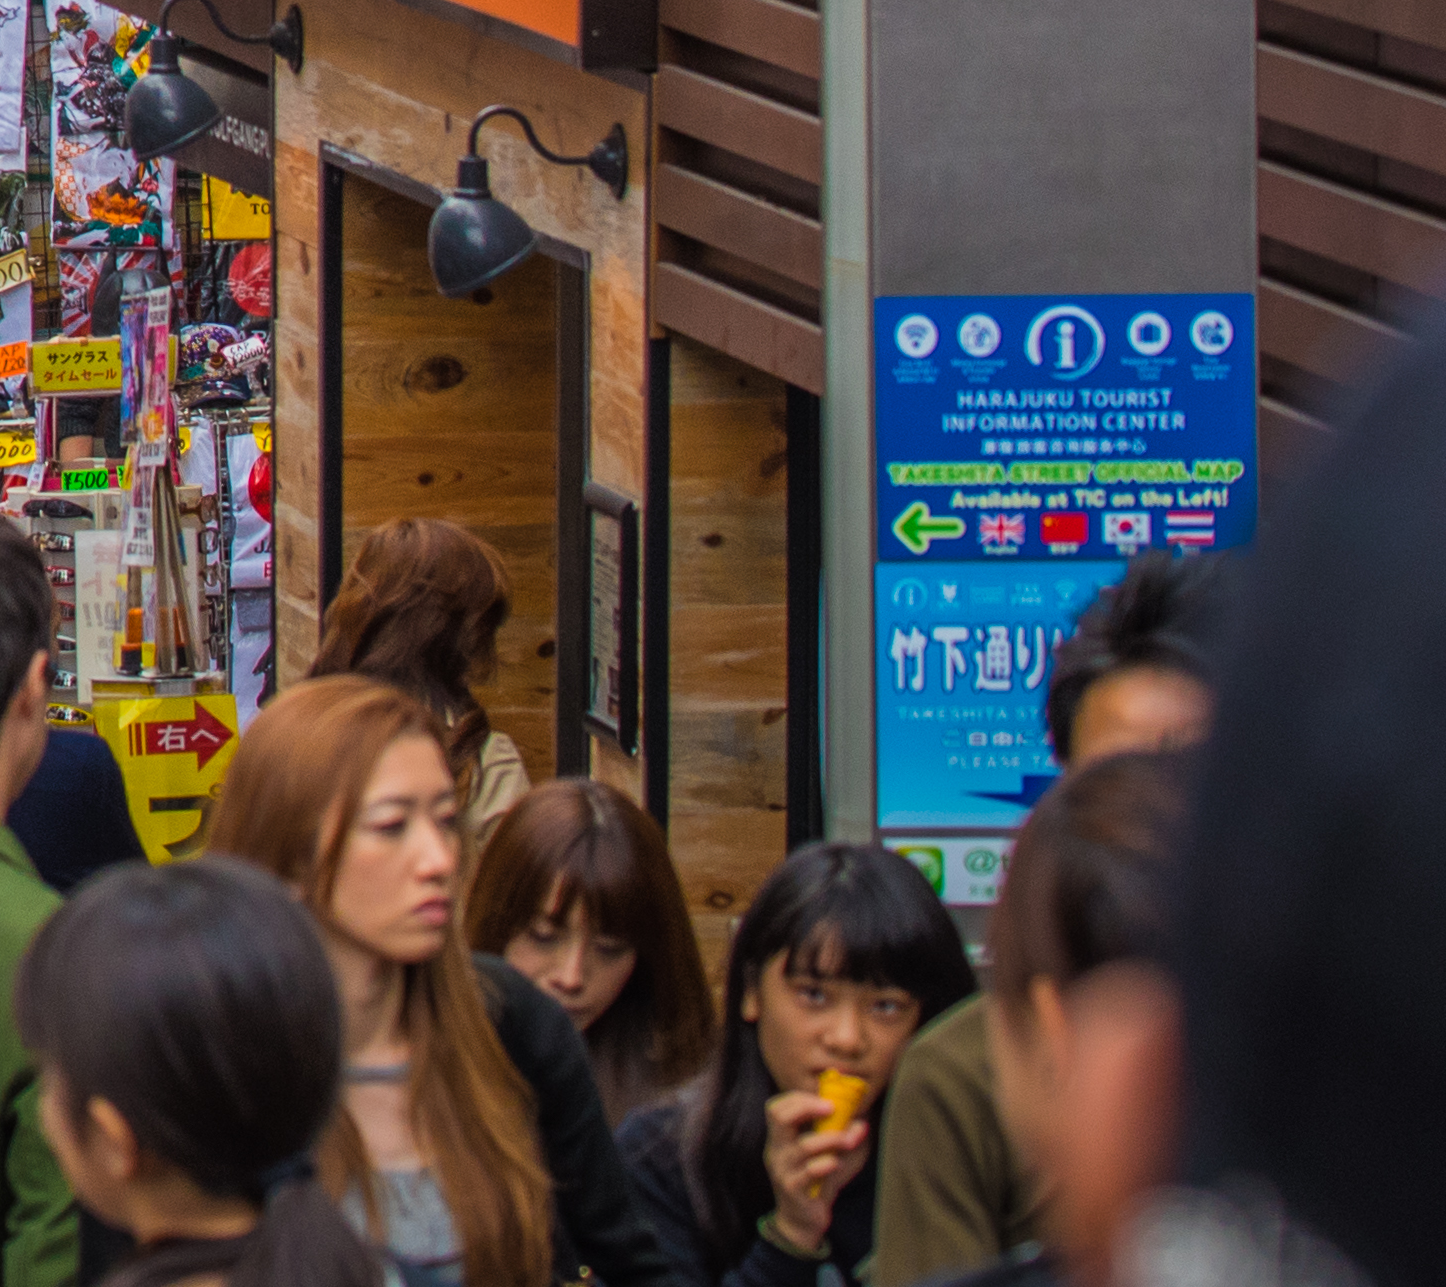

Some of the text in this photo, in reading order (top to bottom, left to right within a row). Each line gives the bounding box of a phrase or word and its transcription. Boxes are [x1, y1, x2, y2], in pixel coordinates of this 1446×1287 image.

[47, 350, 110, 365] サングラス
[958, 388, 1173, 409] HARAJUKU TOURIST
[942, 412, 1187, 433] INFORMATION CENTER
[63, 469, 109, 490] ¥500
[156, 724, 220, 751] 右へ
